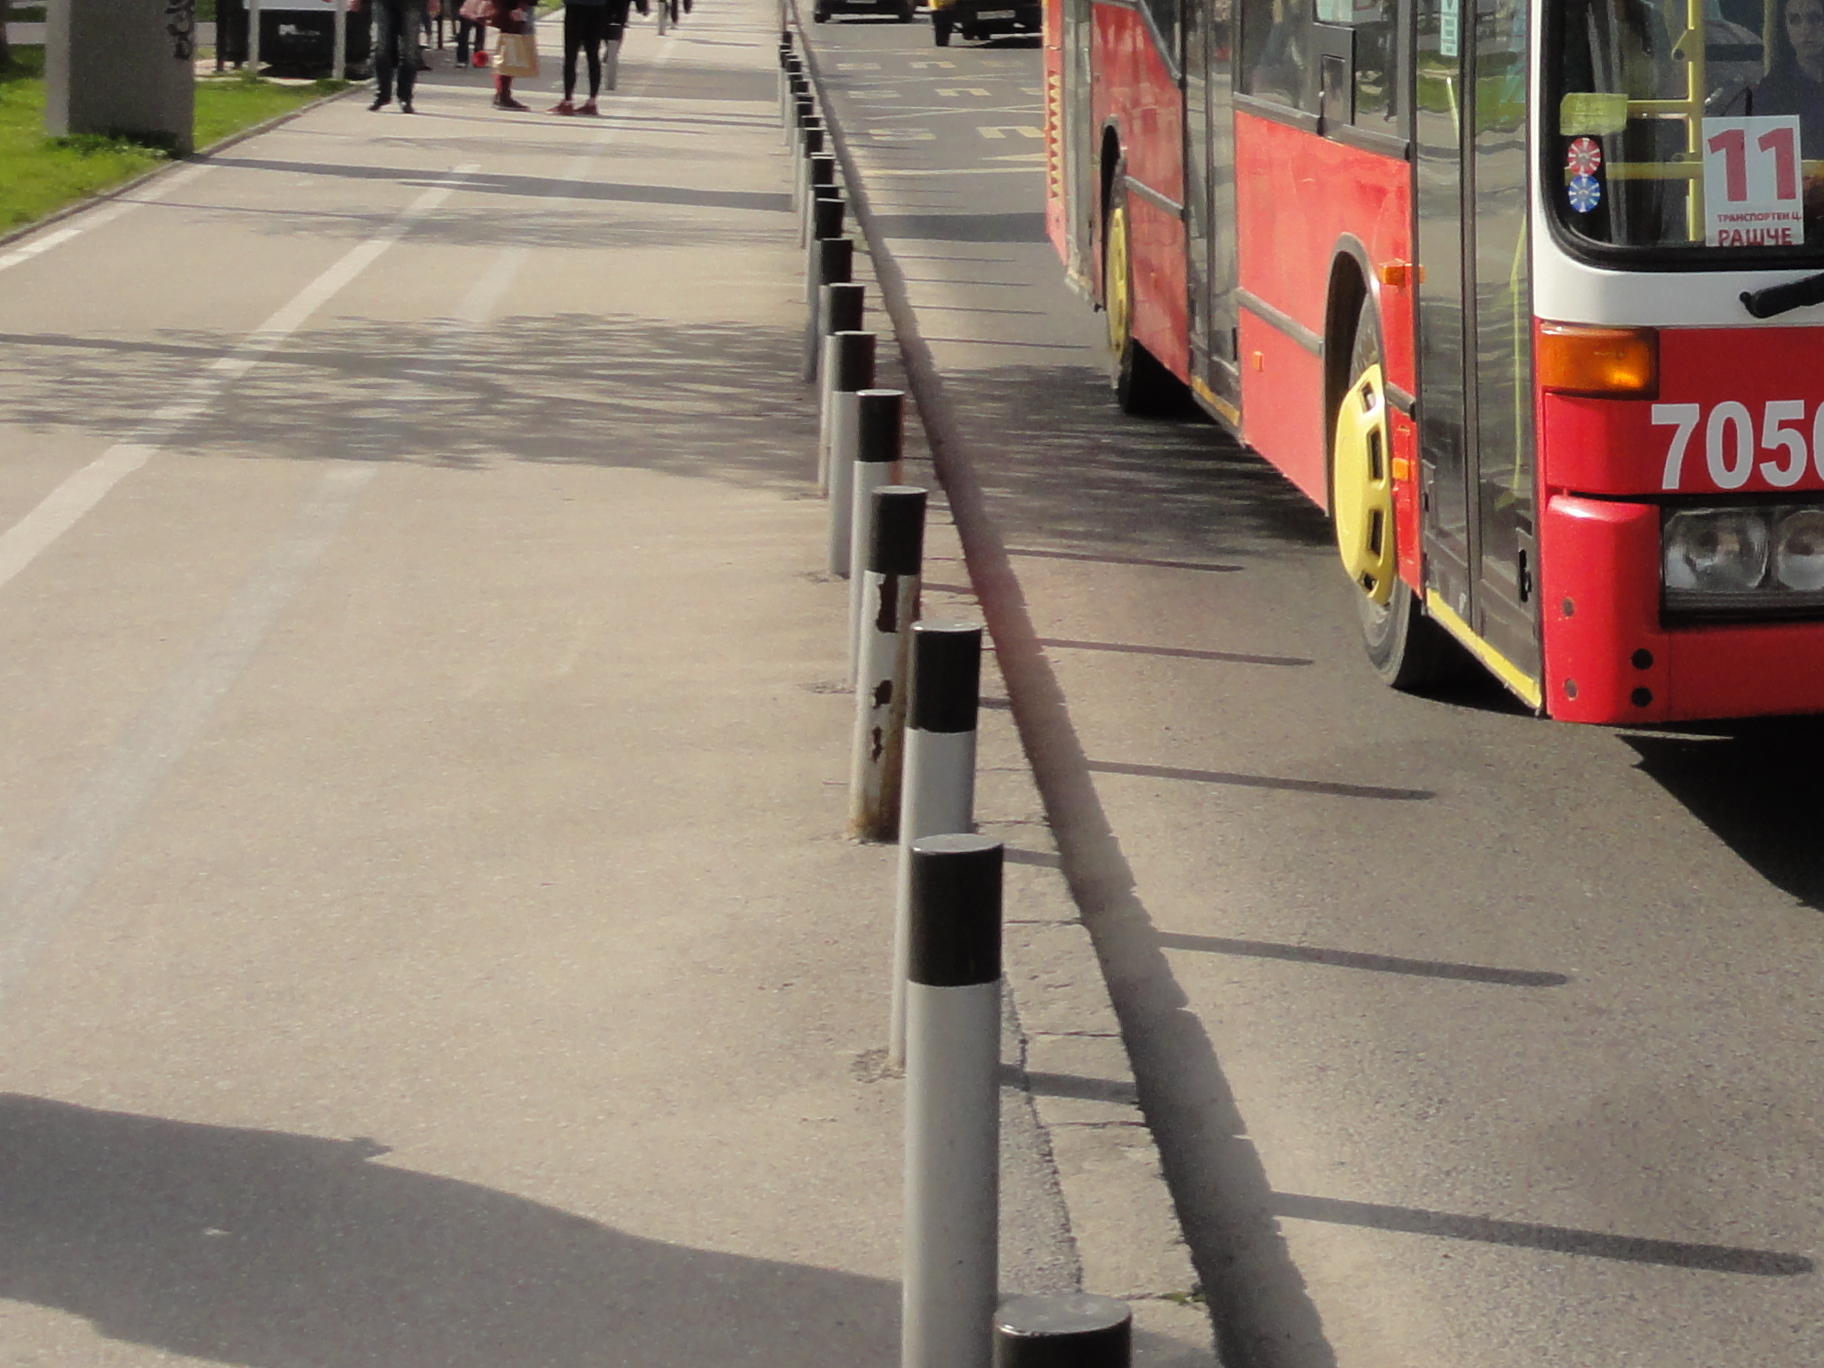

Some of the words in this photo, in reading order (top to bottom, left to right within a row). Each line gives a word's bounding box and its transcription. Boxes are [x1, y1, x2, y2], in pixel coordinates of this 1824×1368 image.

[1707, 127, 1797, 202] 11
[1717, 212, 1791, 223] ТРАНСПОРТЕН
[1717, 227, 1794, 247] РАШЧЕ
